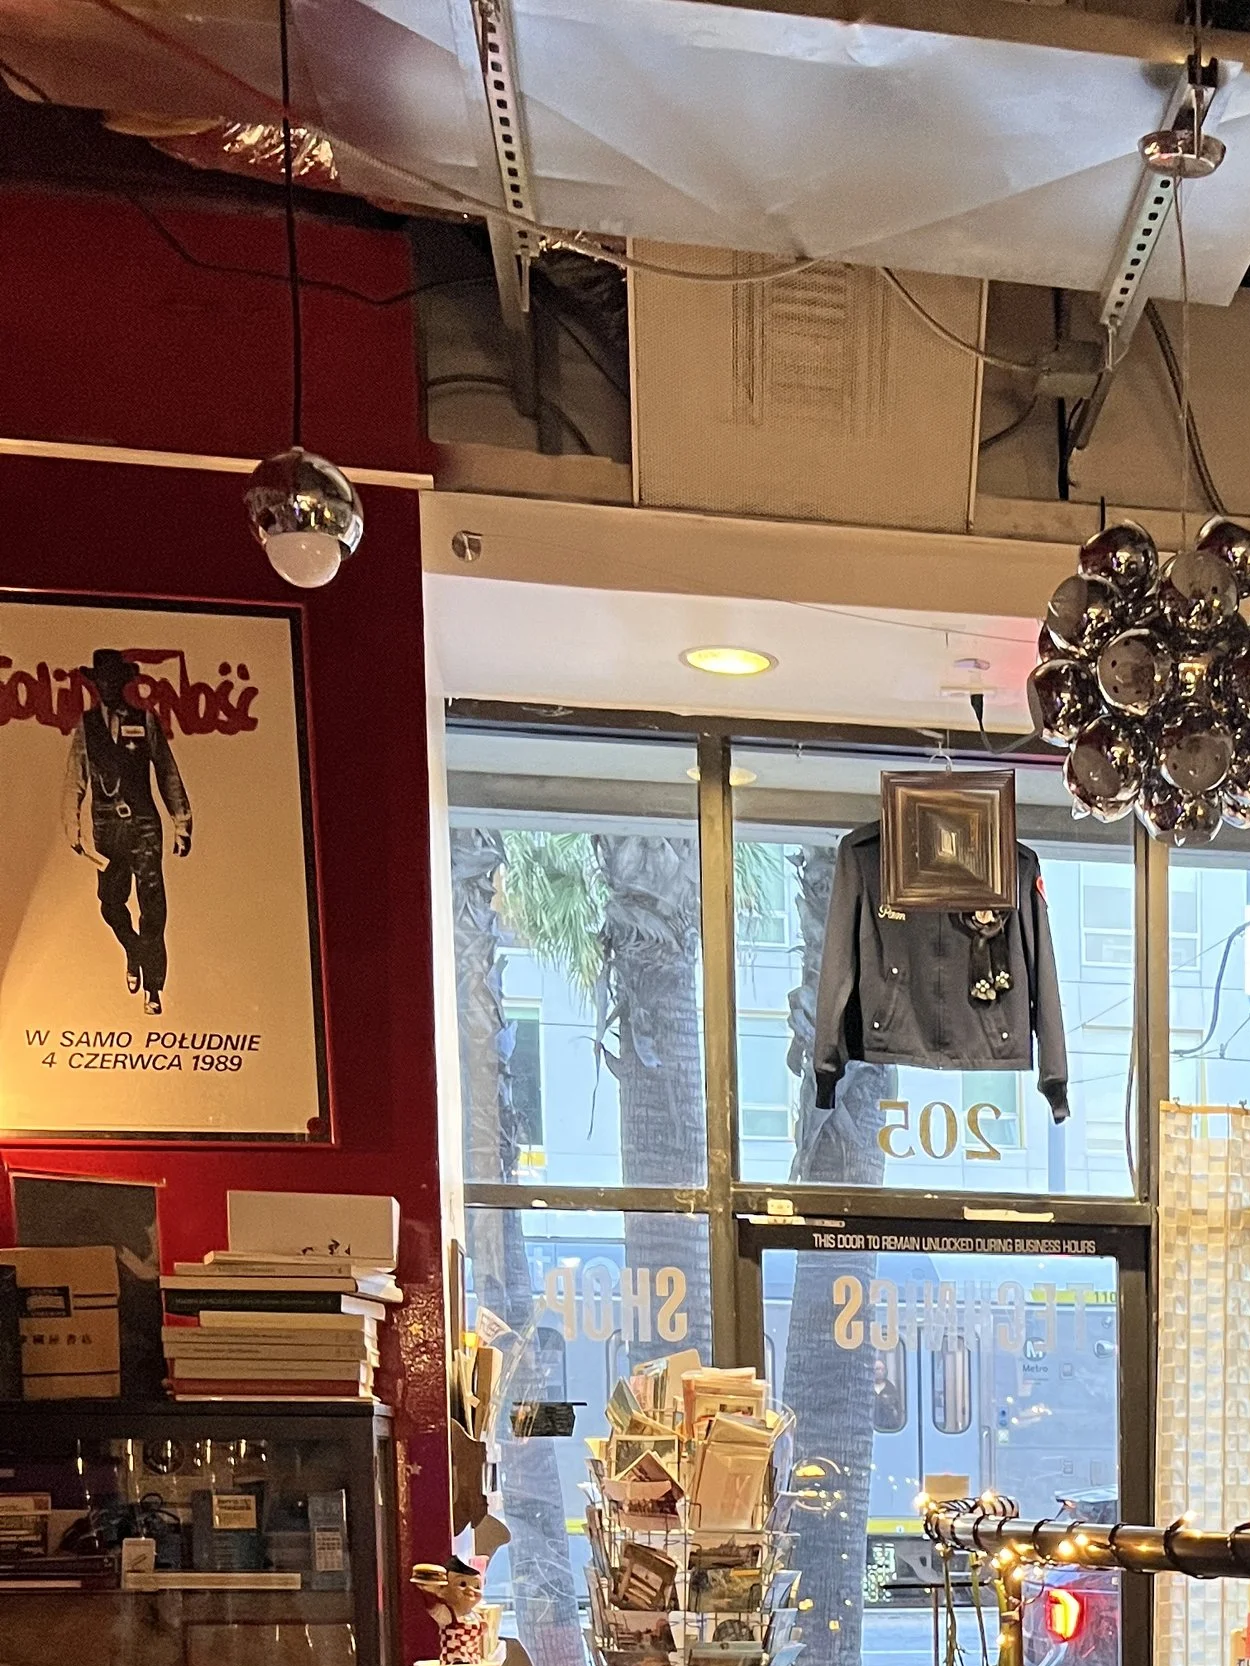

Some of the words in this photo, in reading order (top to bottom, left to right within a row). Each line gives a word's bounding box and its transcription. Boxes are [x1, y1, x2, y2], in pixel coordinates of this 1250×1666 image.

[26, 1030, 50, 1046] W
[59, 1030, 133, 1048] SAMO
[145, 1032, 261, 1051] POŁUDNIE
[41, 1052, 57, 1068] 4
[68, 1053, 182, 1071] CZERWCA
[192, 1055, 243, 1072] 1989
[812, 1233, 836, 1249] THIS
[837, 1234, 865, 1249] DOOR
[866, 1235, 880, 1249] TO
[882, 1236, 921, 1250] REMAIN
[922, 1237, 974, 1251] UNLOCKED
[975, 1238, 1013, 1252] DURING
[1014, 1239, 1061, 1253] BUSINESS
[1062, 1240, 1096, 1254] HOURS
[1022, 1364, 1049, 1374] Metro
